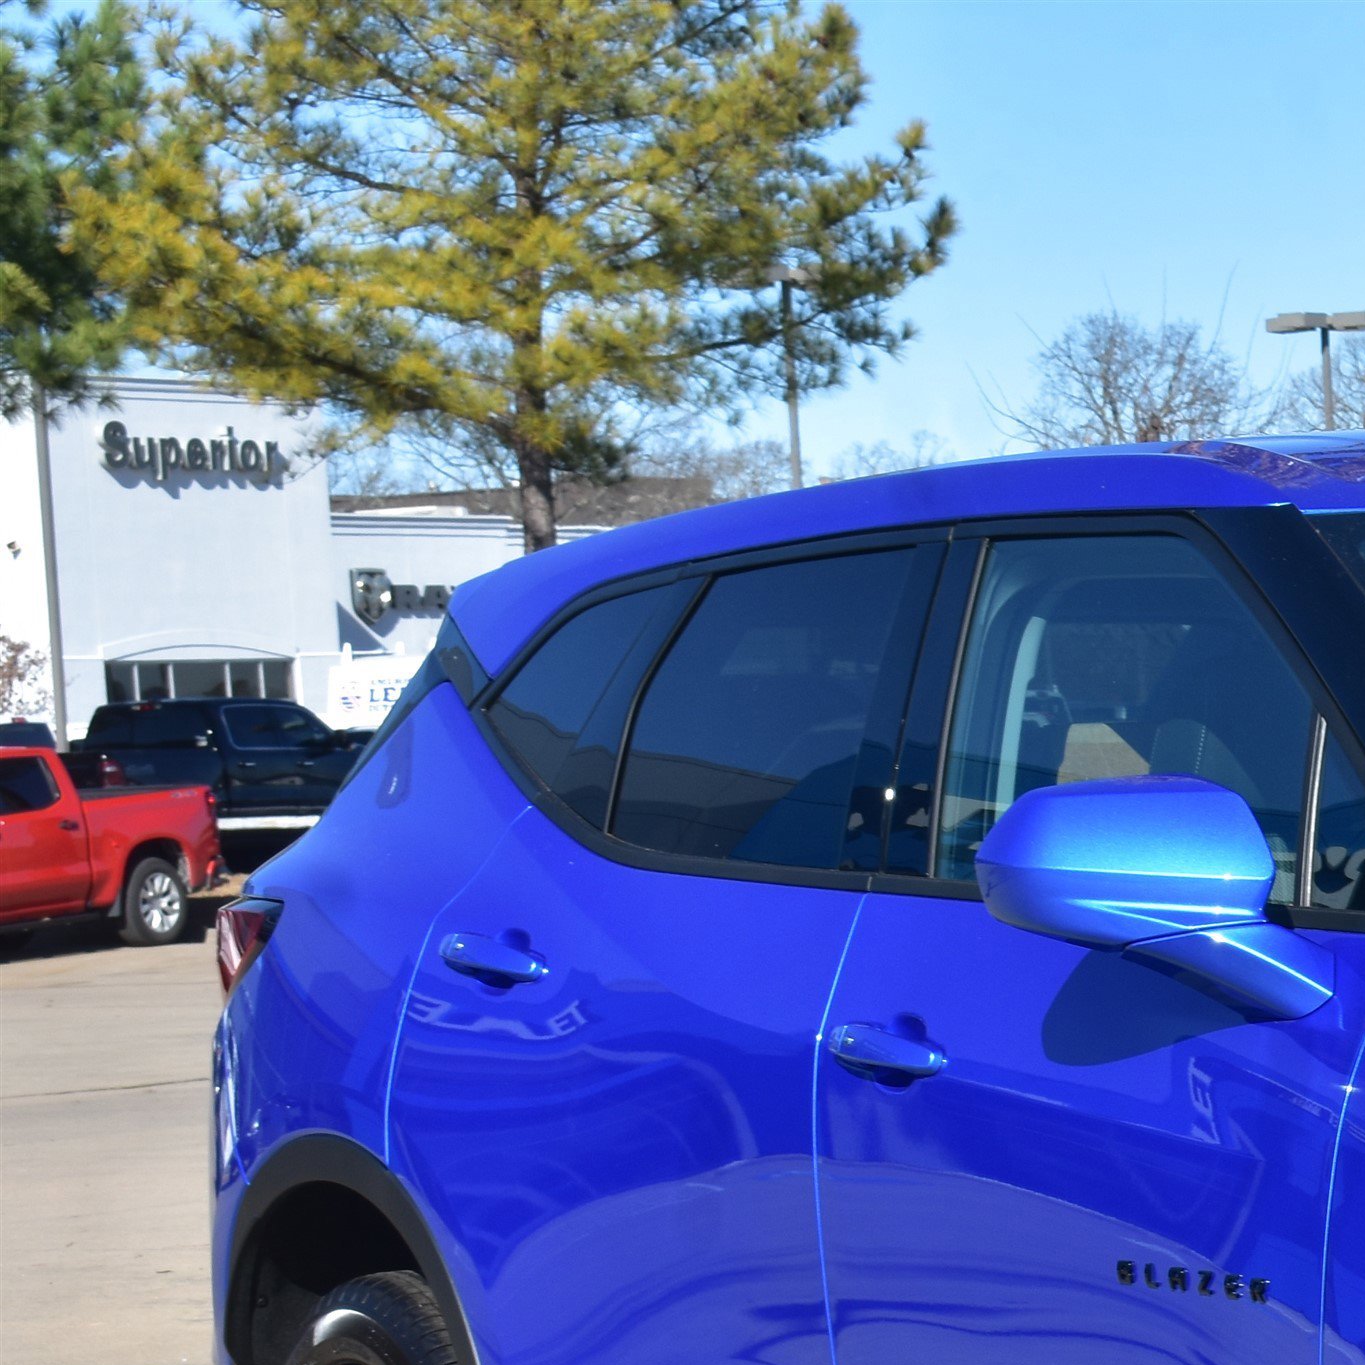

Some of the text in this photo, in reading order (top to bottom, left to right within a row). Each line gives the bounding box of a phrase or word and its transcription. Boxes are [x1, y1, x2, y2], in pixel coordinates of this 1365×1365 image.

[103, 420, 279, 481] Superior
[390, 584, 456, 609] RA
[1117, 1259, 1270, 1304] BLAZER
